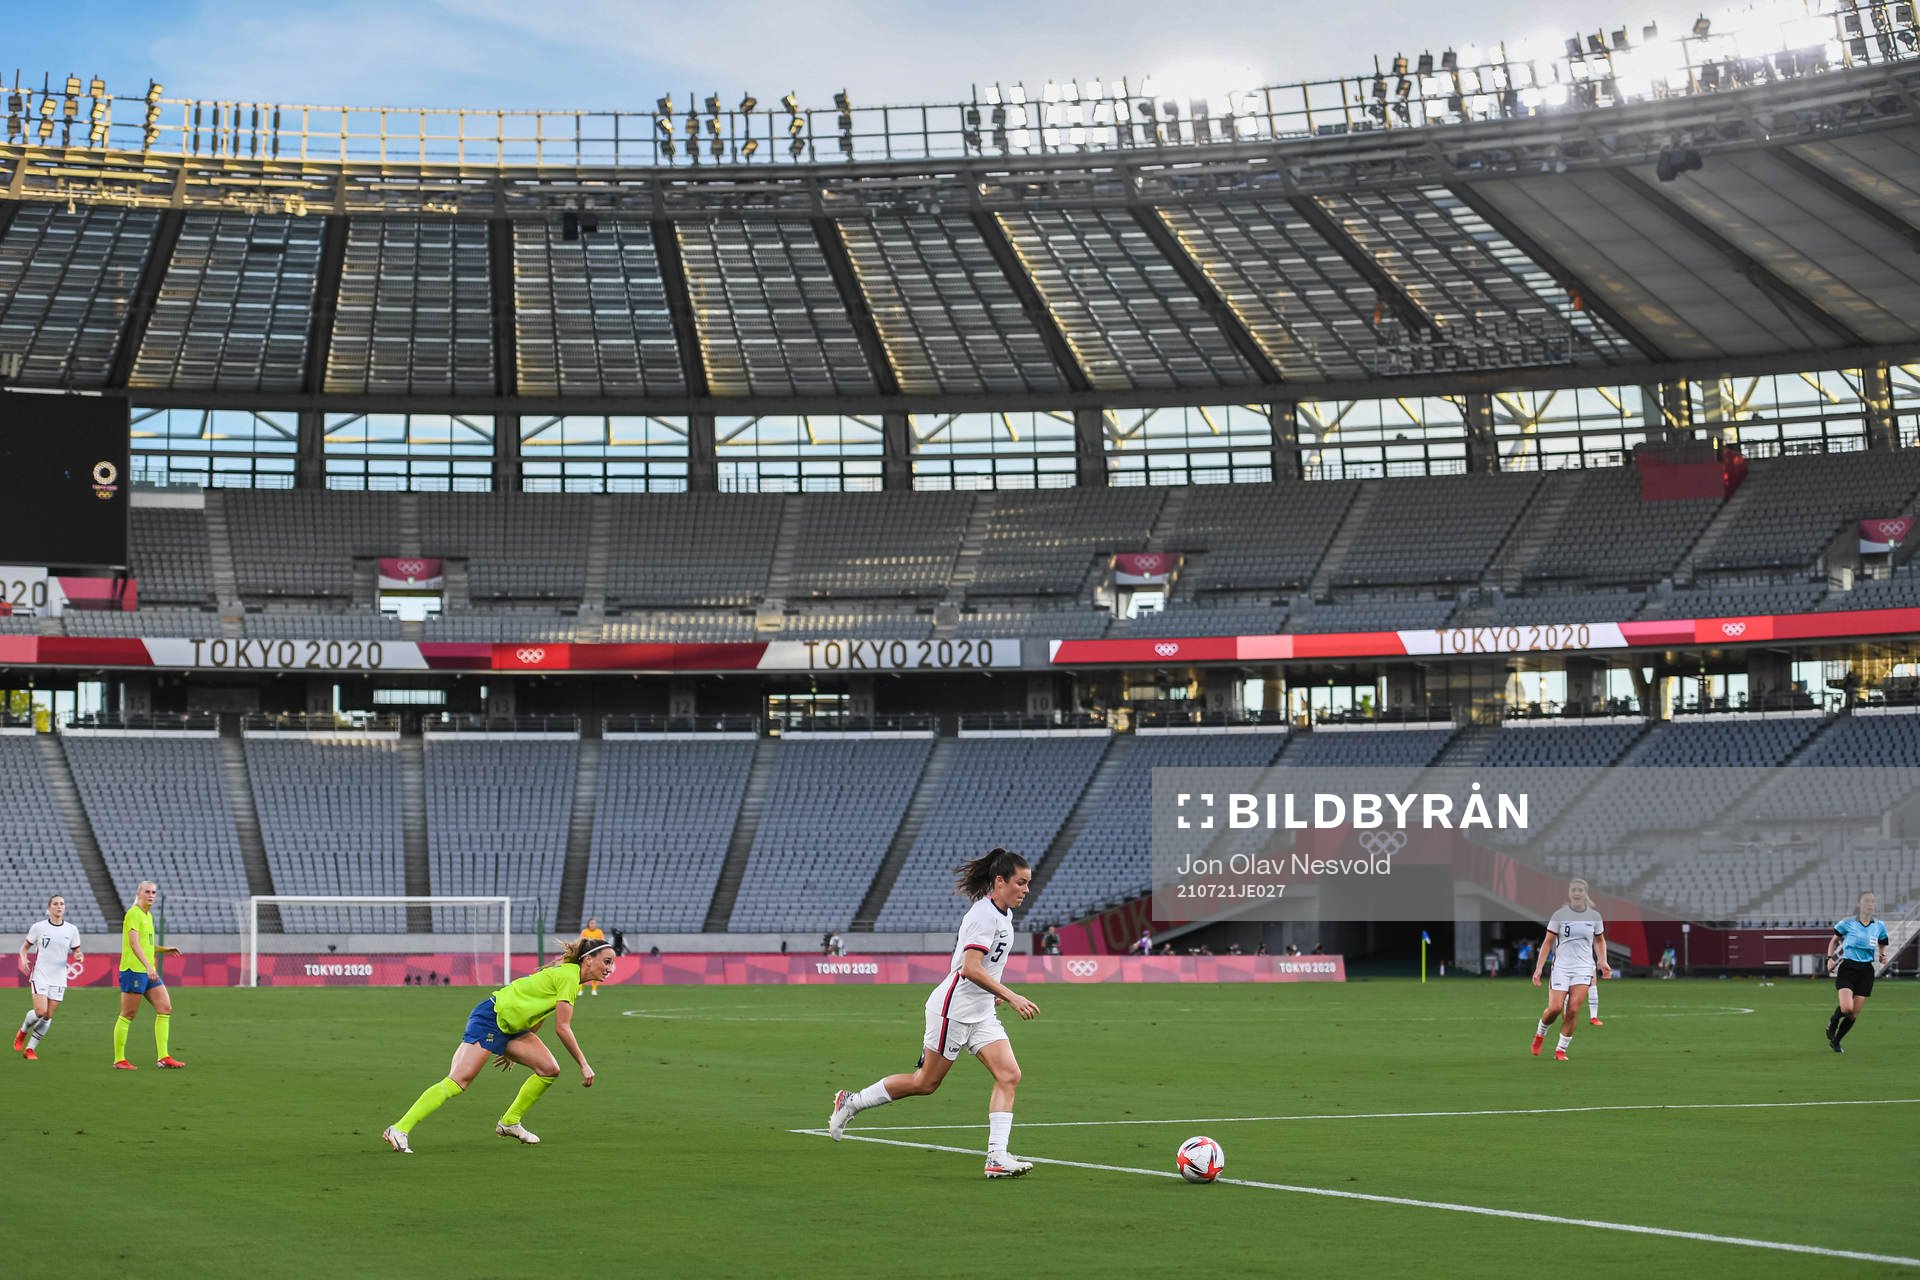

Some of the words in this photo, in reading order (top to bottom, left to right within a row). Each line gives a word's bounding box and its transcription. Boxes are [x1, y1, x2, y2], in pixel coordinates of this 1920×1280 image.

[1435, 626, 1520, 654] TOKYO
[1529, 624, 1590, 651] 2020
[189, 639, 295, 669] TOKYO
[306, 640, 382, 669] 2020
[803, 640, 907, 669] TOKYO
[917, 640, 992, 668] 2020
[1563, 925, 1571, 938] 9
[42, 937, 51, 950] 17
[990, 941, 1007, 962] 5
[304, 964, 343, 976] TOKYO
[344, 964, 373, 976] 2020
[816, 963, 851, 975] TOKYO
[852, 963, 879, 975] 2020
[1280, 962, 1311, 974] TOKYO
[1312, 962, 1337, 973] 2020
